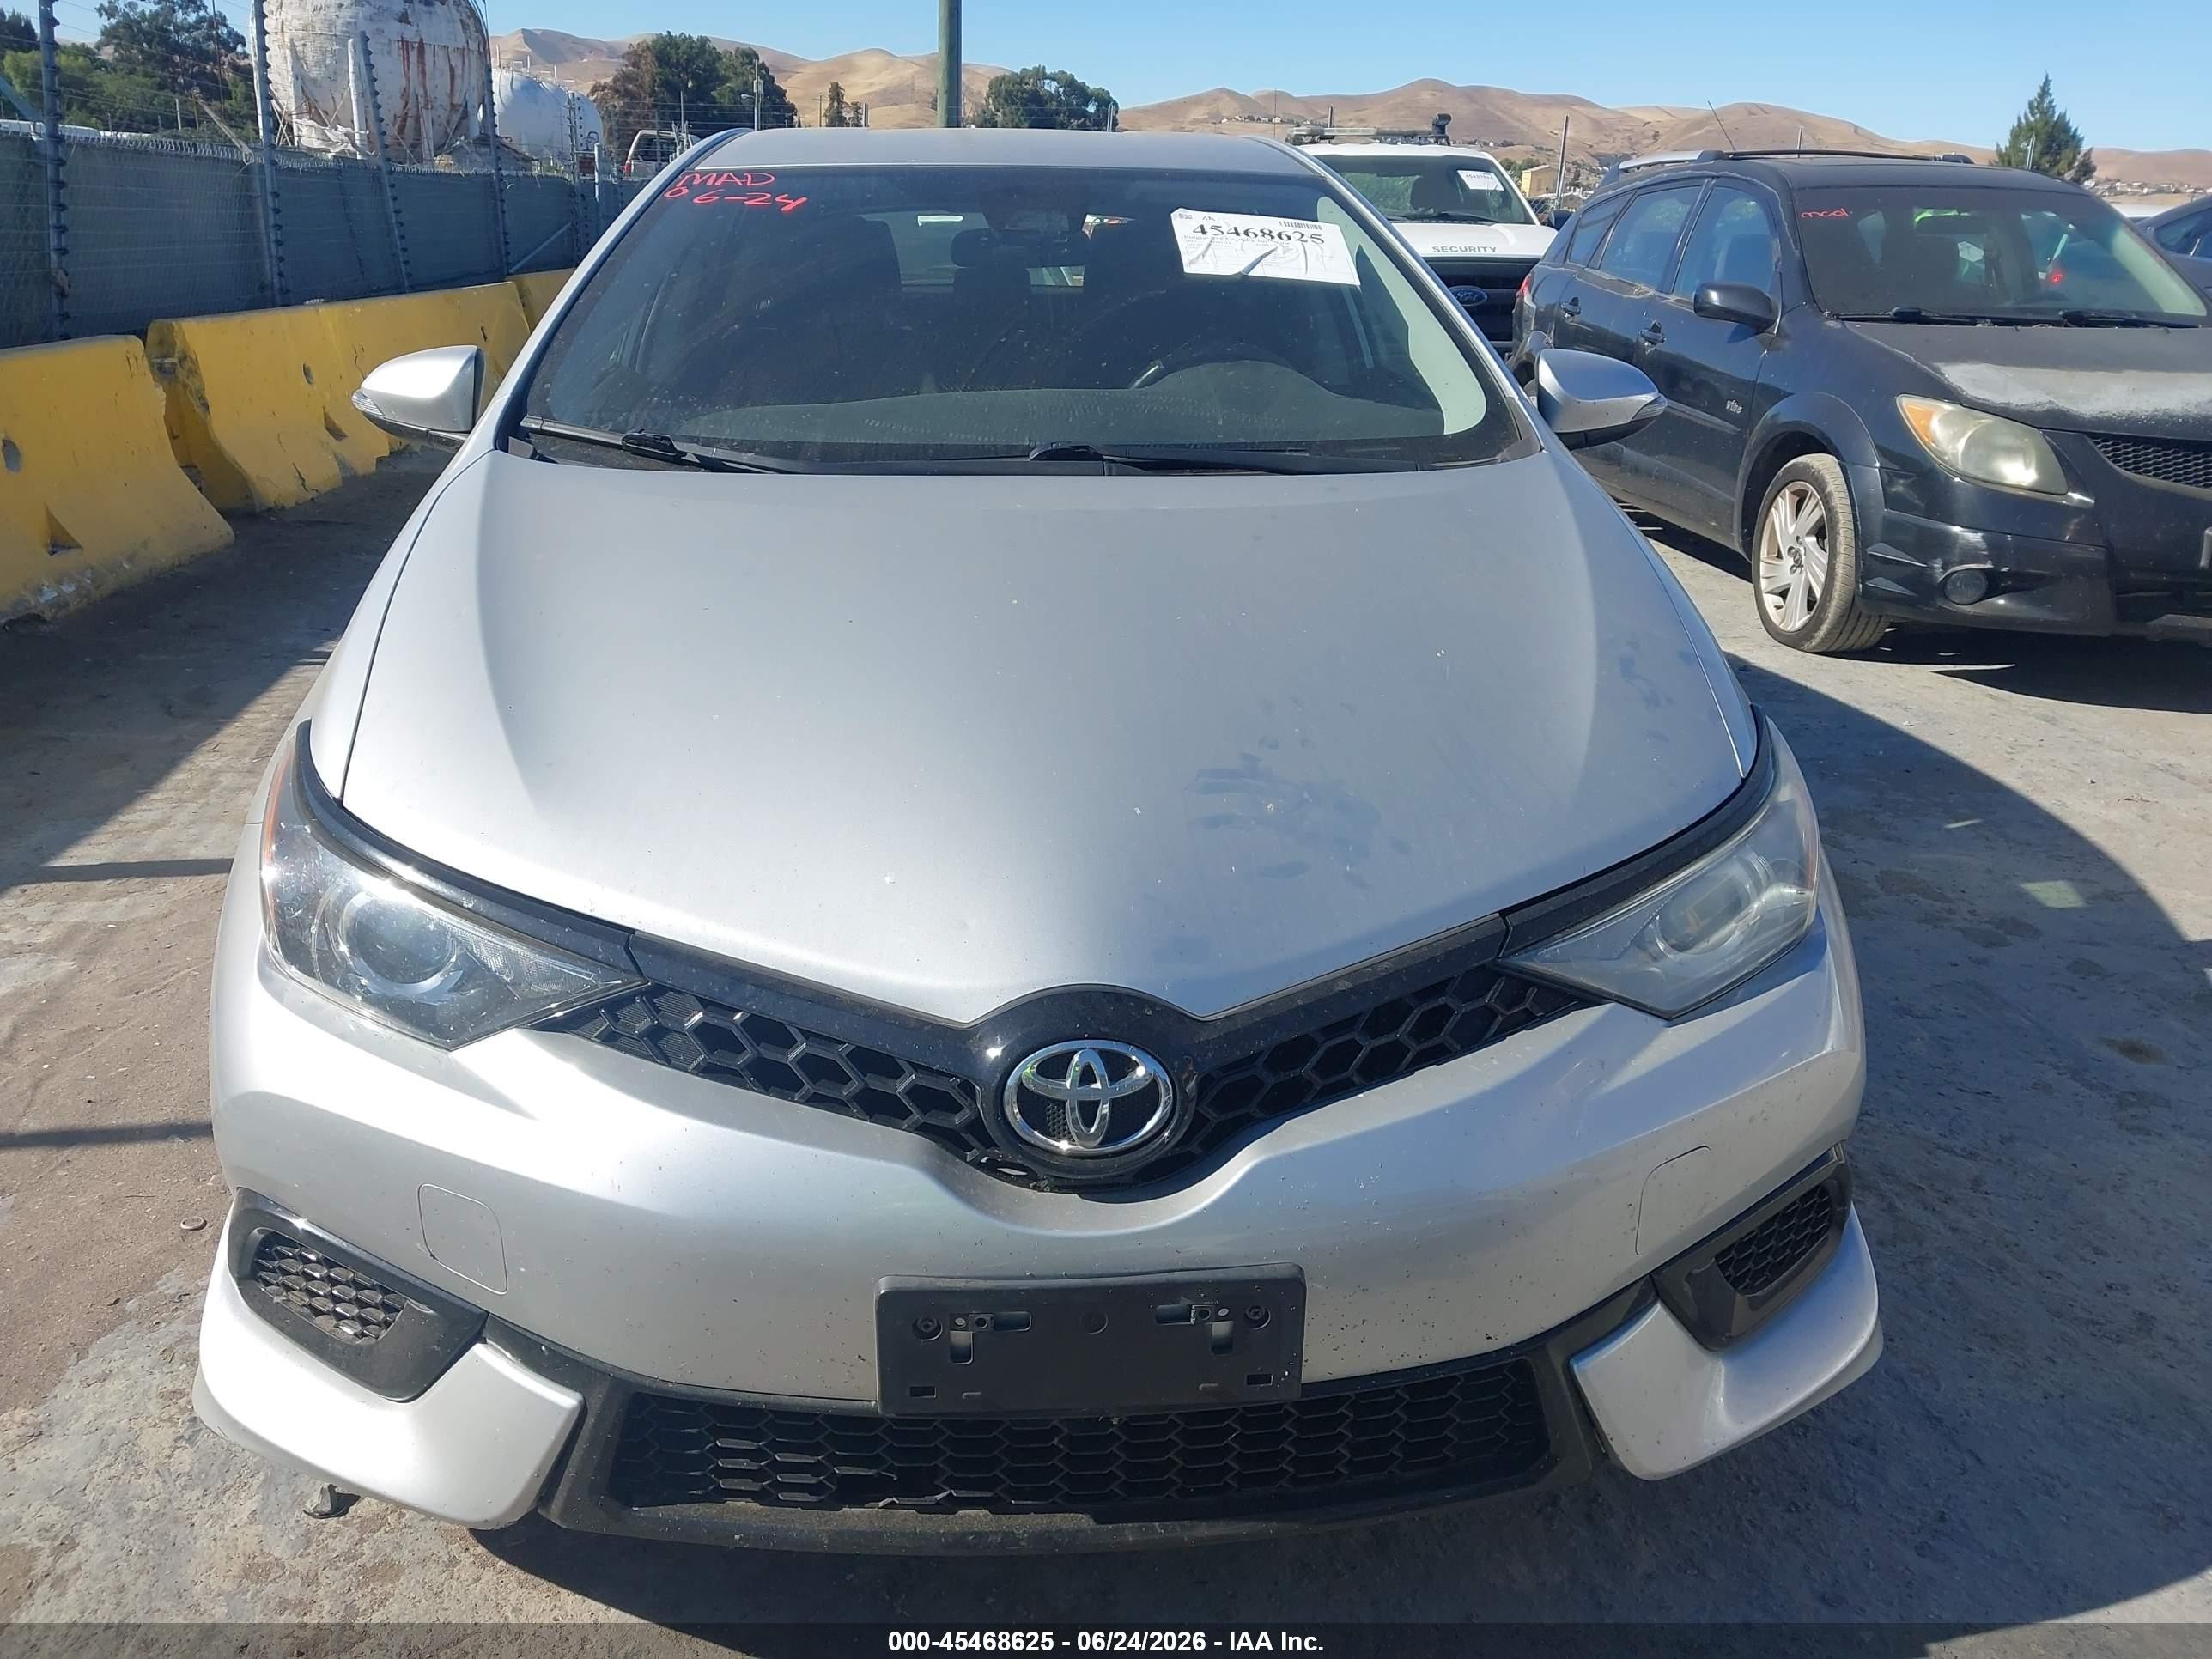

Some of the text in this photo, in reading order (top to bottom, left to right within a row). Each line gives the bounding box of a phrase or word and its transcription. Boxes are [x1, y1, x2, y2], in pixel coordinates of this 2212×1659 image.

[676, 172, 776, 187] MAD
[664, 186, 809, 212] 06-24
[1192, 223, 1325, 245] 45468625
